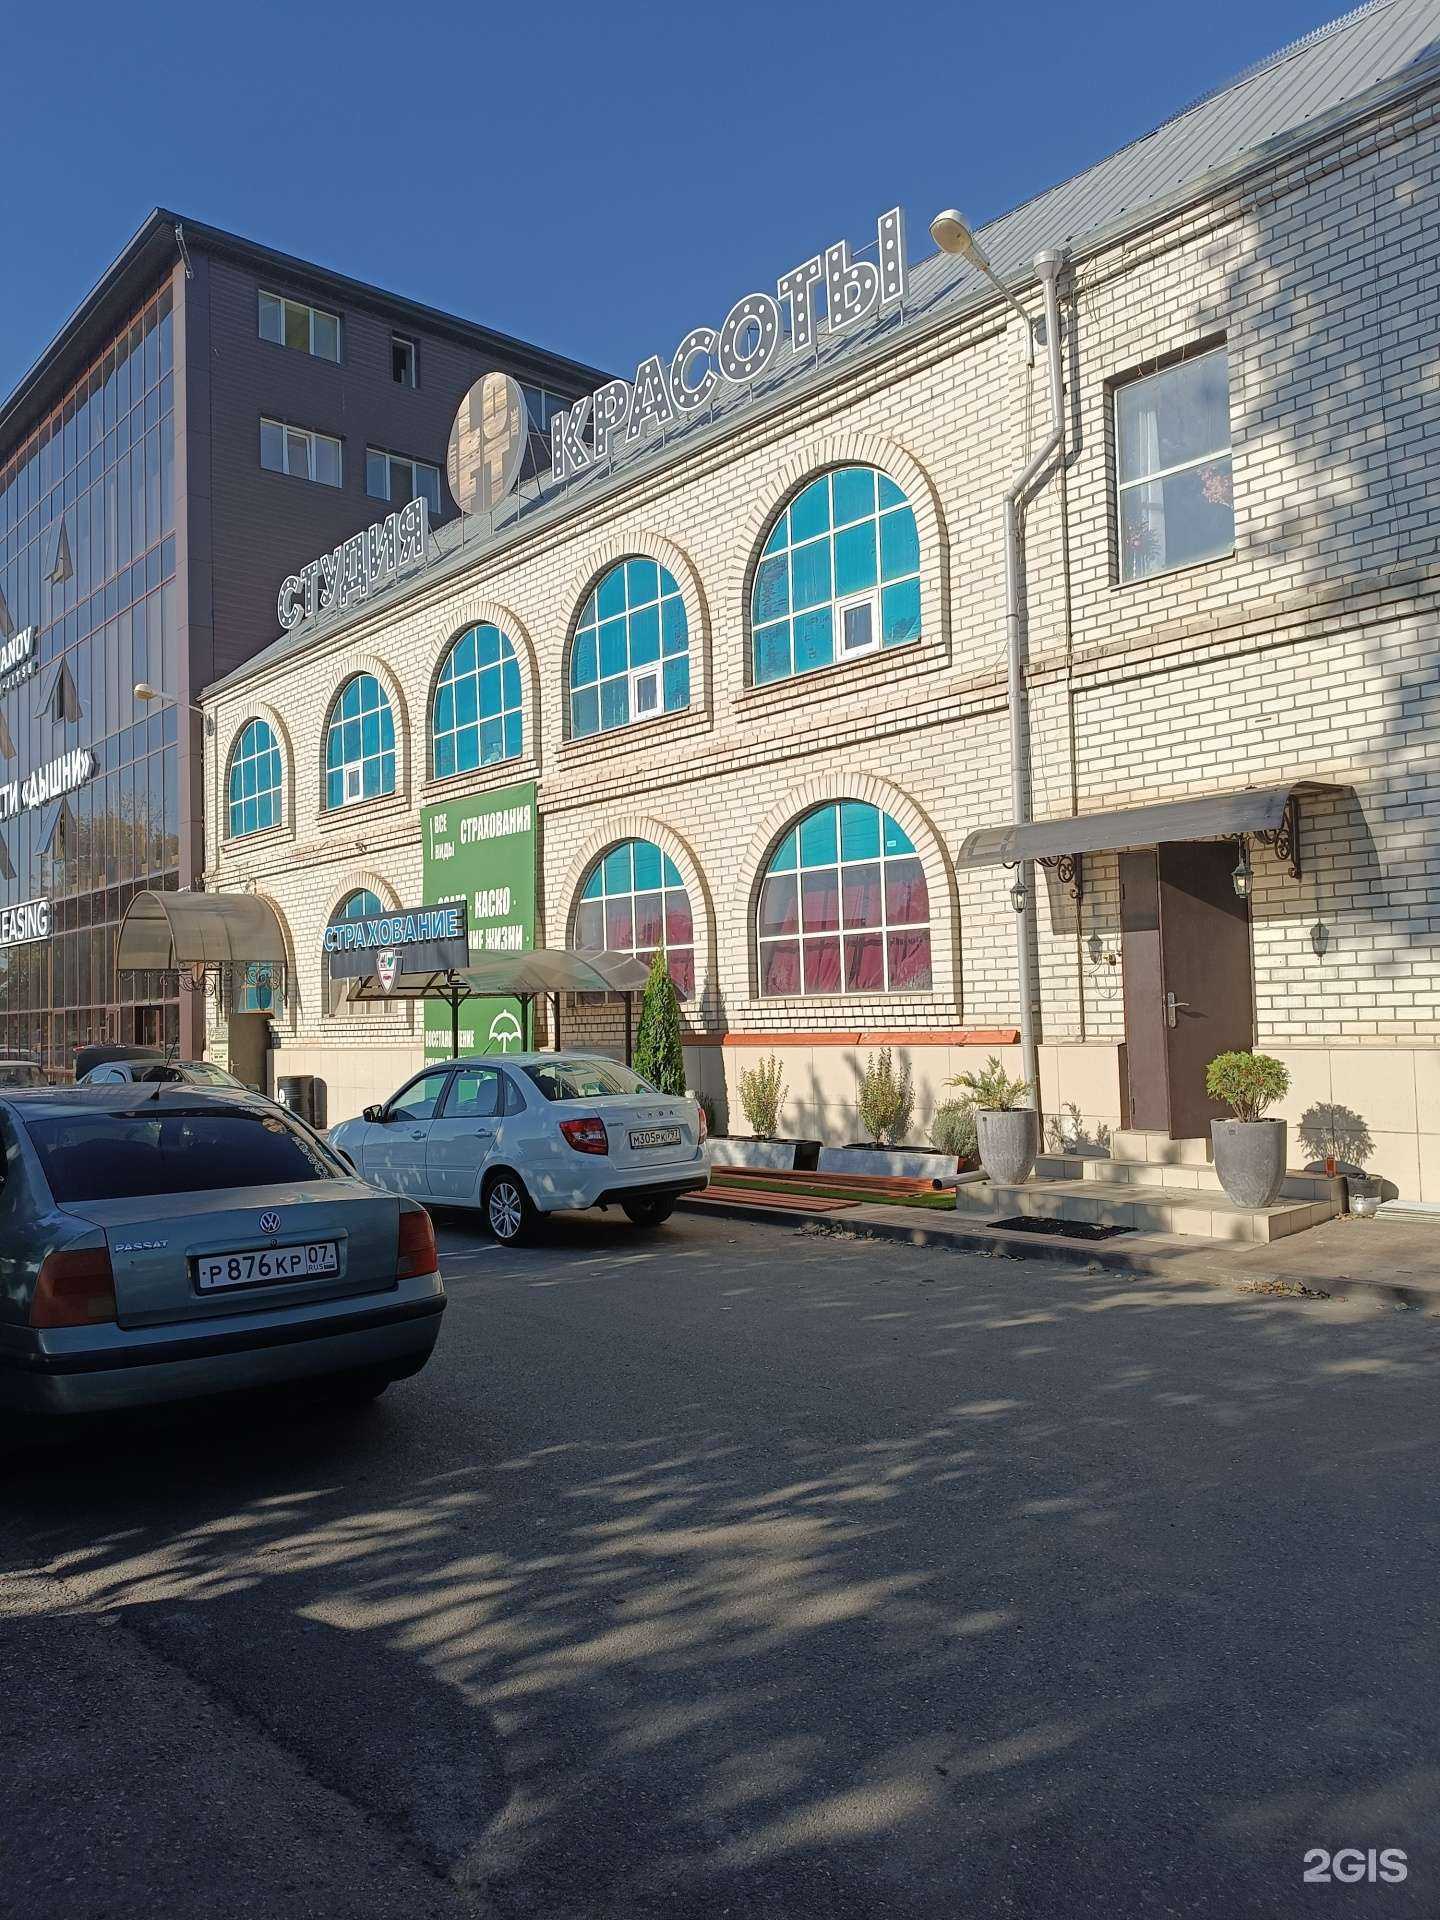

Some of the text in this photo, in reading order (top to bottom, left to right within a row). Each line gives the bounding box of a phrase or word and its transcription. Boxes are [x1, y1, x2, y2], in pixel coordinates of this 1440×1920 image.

[277, 206, 907, 631] СТУДИЯ КРАСОТЫ
[0, 625, 32, 672] ANOV
[0, 780, 18, 820] ТИ
[434, 813, 447, 833] ВСЕ
[460, 804, 531, 844] СТРАХОВАНИЯ
[474, 886, 511, 918] КАСКО
[0, 902, 48, 943] EASING
[323, 909, 459, 952] СТРАХОВАНИЕ
[485, 924, 523, 950] ЖИЗНИ
[115, 1240, 169, 1253] PASSAT
